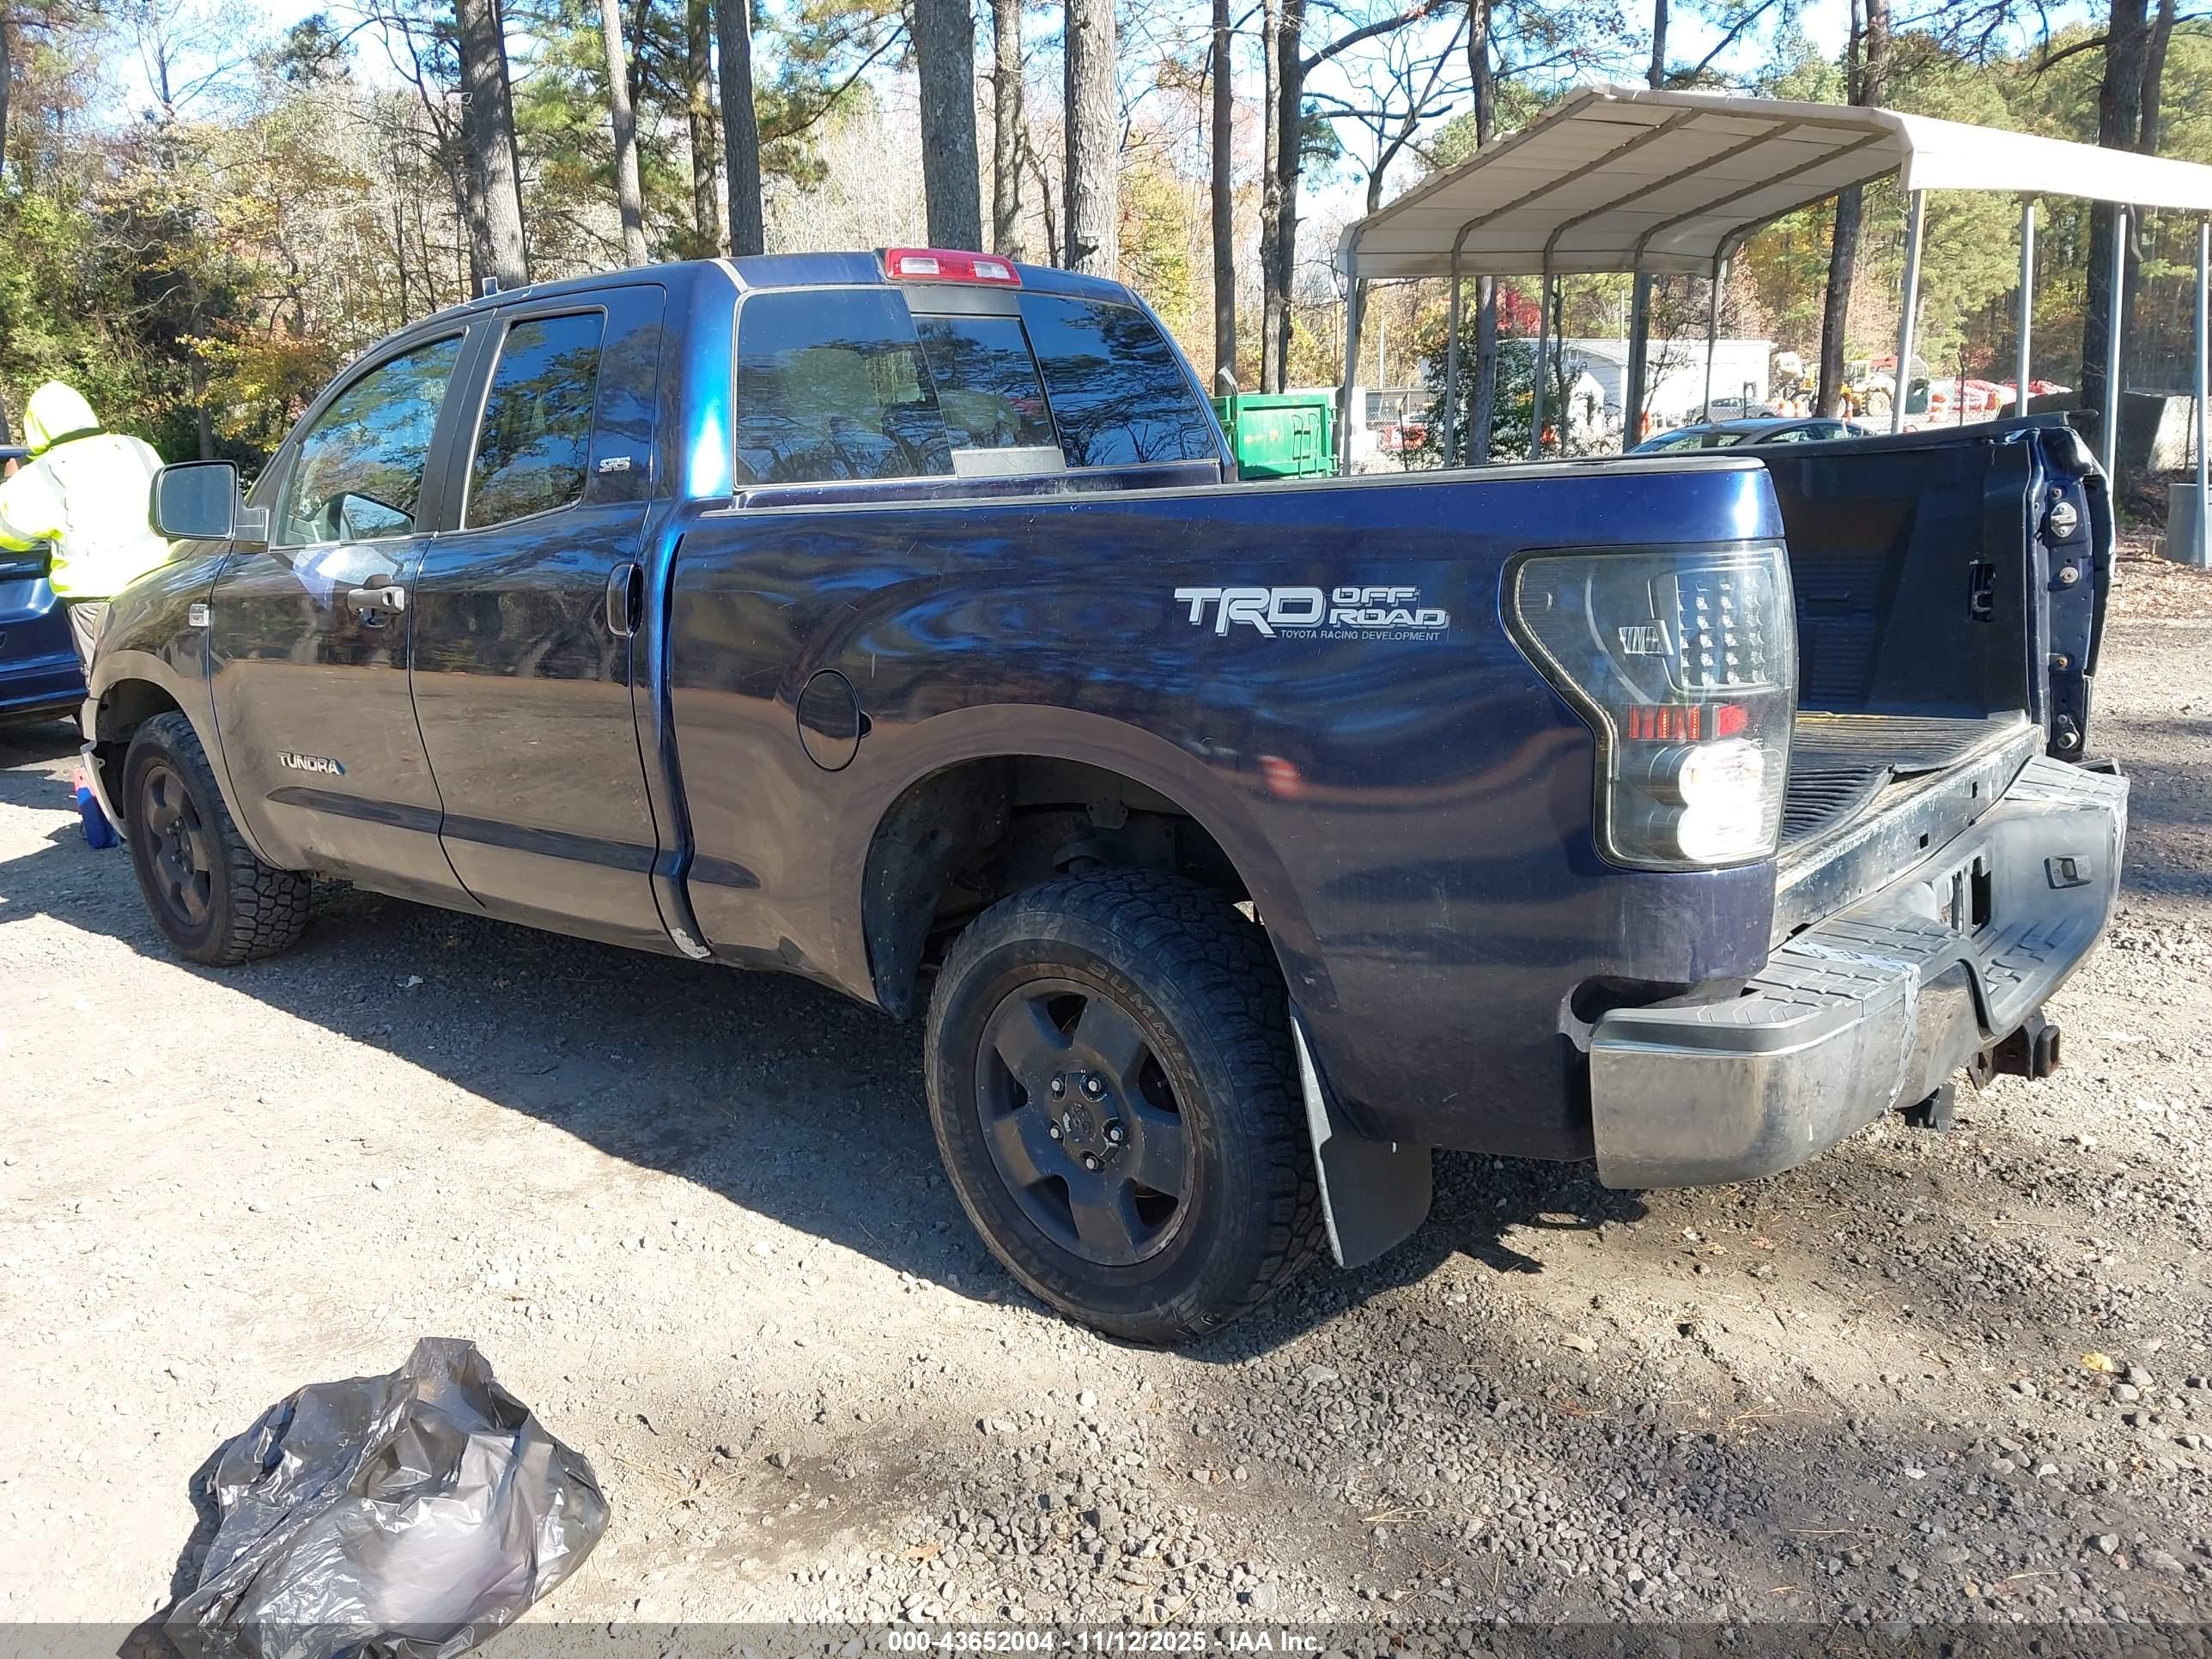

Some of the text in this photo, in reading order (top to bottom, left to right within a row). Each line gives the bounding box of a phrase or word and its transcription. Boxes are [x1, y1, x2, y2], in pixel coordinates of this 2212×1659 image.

[1331, 586, 1419, 607] OFF
[1174, 586, 1328, 637] TRD
[1328, 608, 1450, 629] ROAD
[1280, 630, 1440, 641] TOYOTA RACING DEVELOPMENT
[277, 751, 343, 775] TUNDRA
[1087, 958, 1200, 1088] SUMMIT
